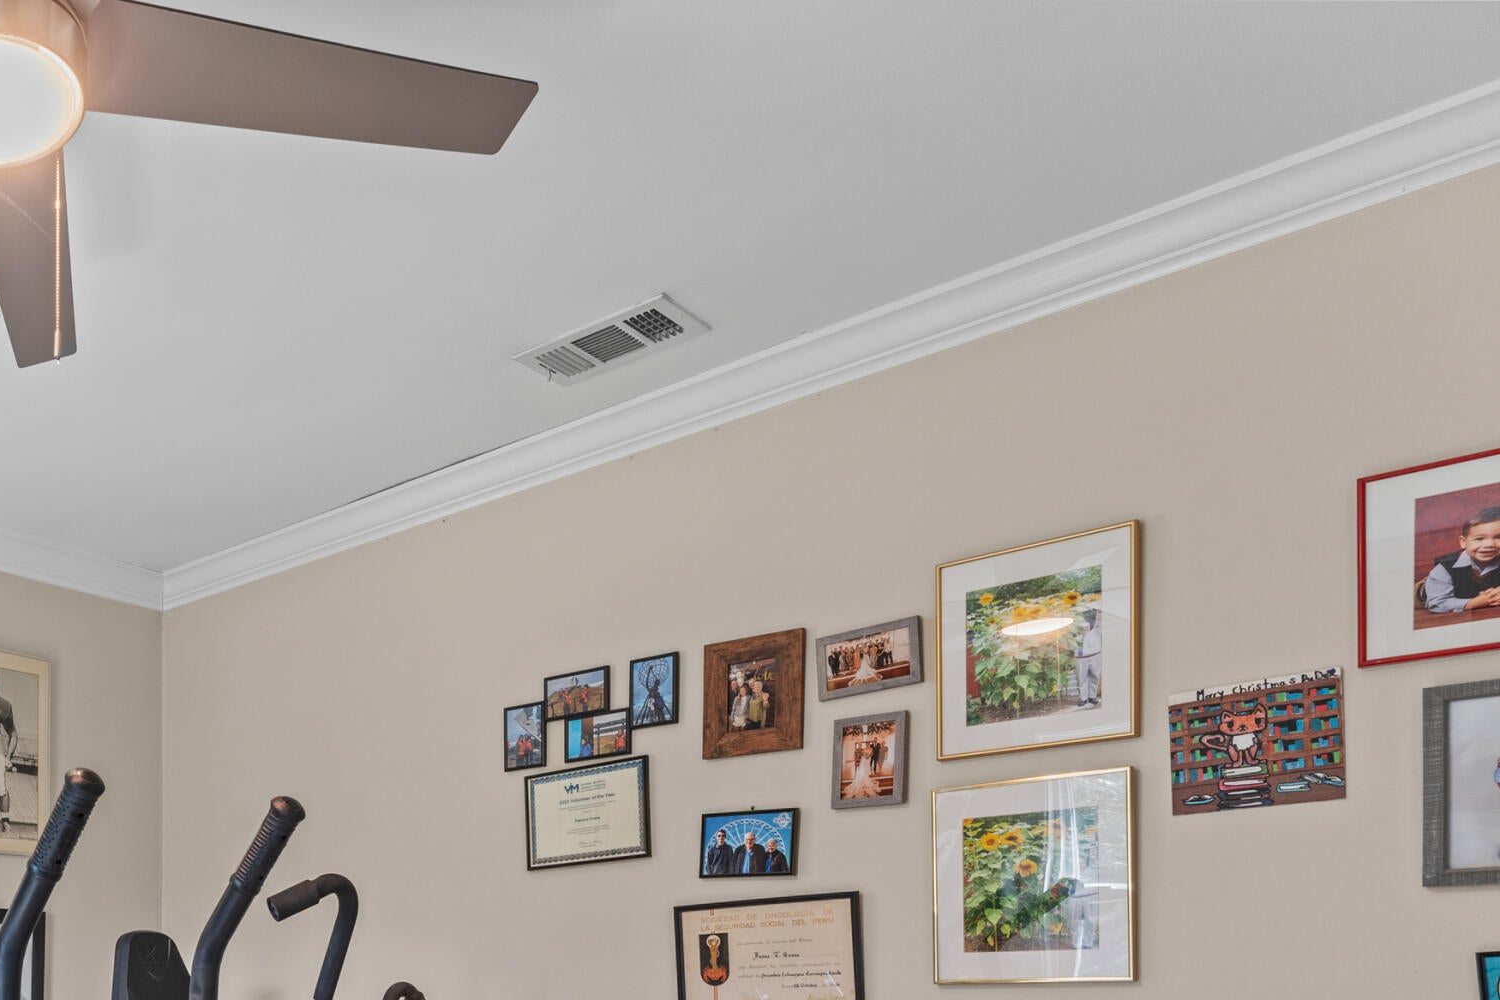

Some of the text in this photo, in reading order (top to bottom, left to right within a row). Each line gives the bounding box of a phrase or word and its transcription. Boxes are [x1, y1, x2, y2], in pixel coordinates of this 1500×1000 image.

[700, 914, 740, 924] SOCIEDAD
[746, 913, 758, 921] DE
[823, 907, 834, 916] DE
[714, 922, 756, 932] SEGURIDAD
[759, 920, 785, 928] SOCIAL
[791, 919, 807, 927] DEL
